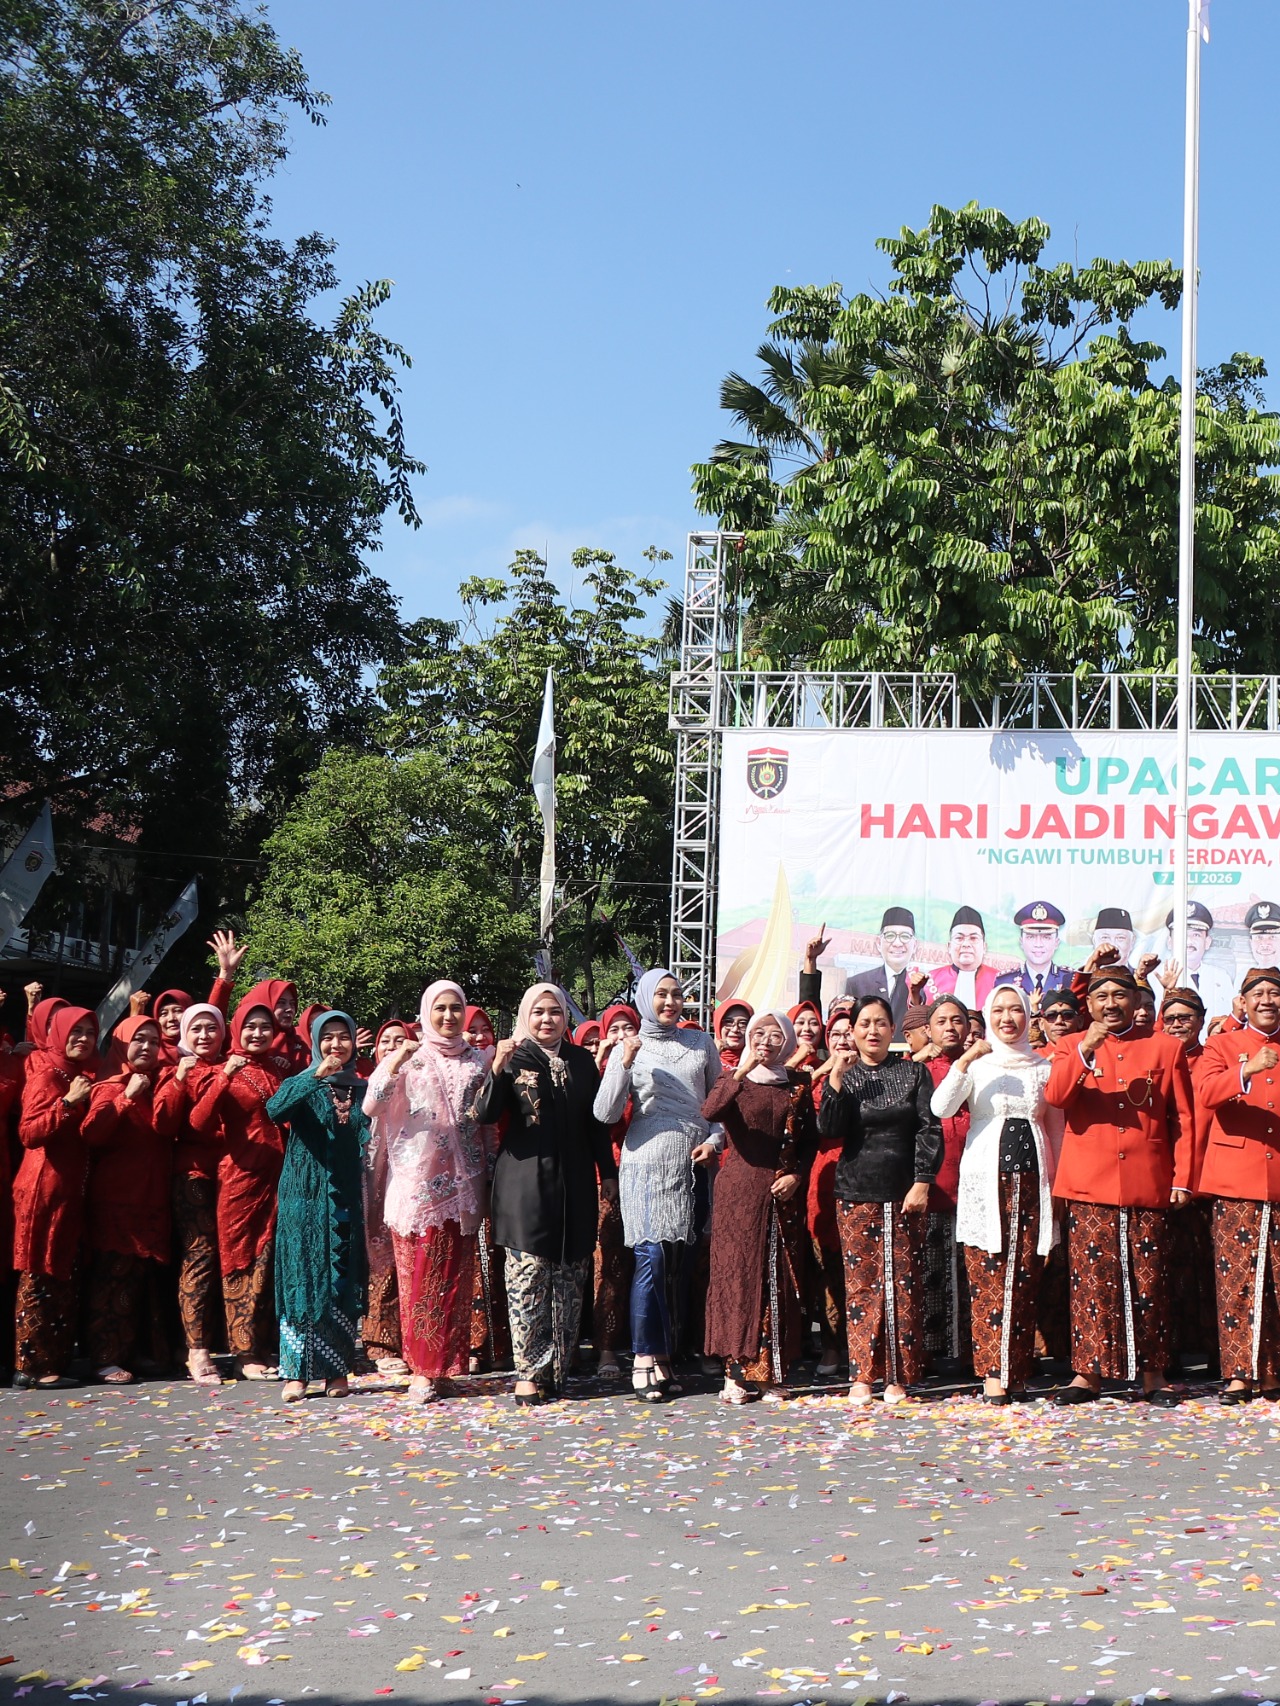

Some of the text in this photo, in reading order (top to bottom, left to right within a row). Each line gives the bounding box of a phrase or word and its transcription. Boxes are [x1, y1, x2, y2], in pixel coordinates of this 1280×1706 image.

[861, 803, 990, 839] HARI
[1005, 804, 1126, 840] JADI
[1067, 849, 1163, 865] TUMBUH
[1161, 873, 1169, 884] 7
[1201, 873, 1233, 884] 2026
